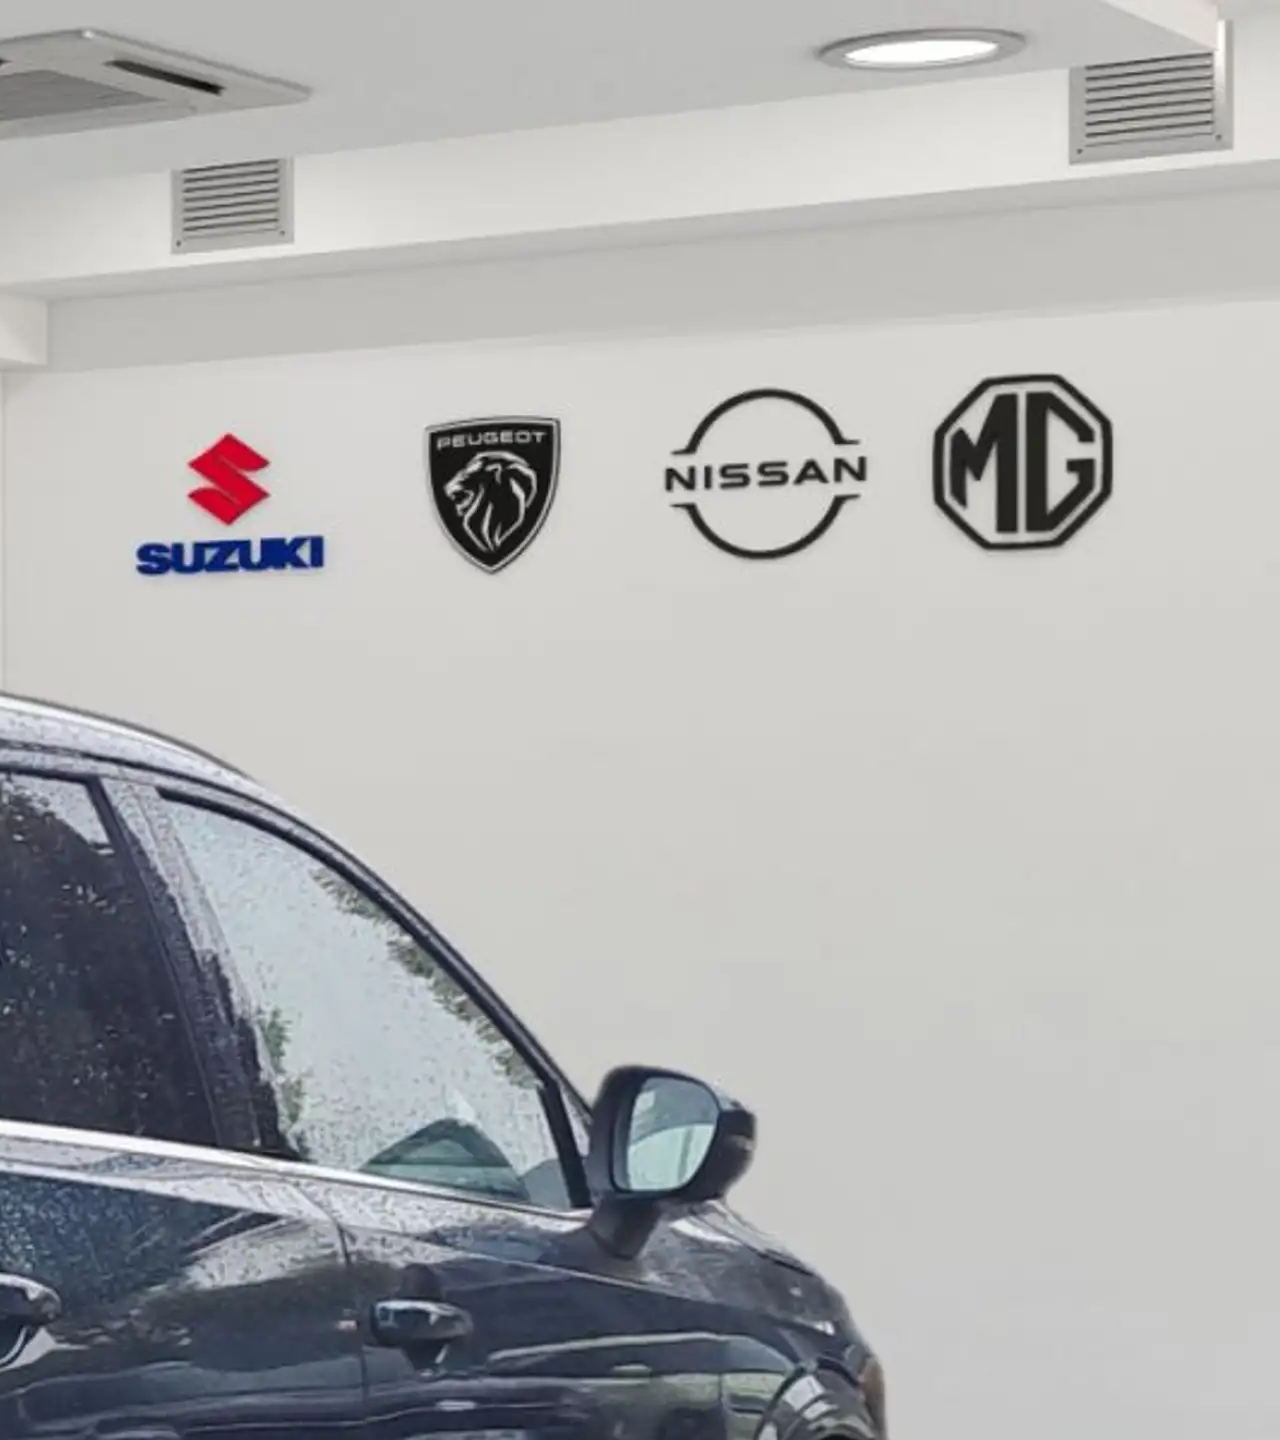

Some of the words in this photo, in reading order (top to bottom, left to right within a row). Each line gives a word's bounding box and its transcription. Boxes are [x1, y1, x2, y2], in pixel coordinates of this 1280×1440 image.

[436, 429, 547, 451] PEUGEOT
[664, 456, 868, 492] NISSAN
[950, 392, 1096, 534] MG
[137, 536, 326, 575] SUZUKI
